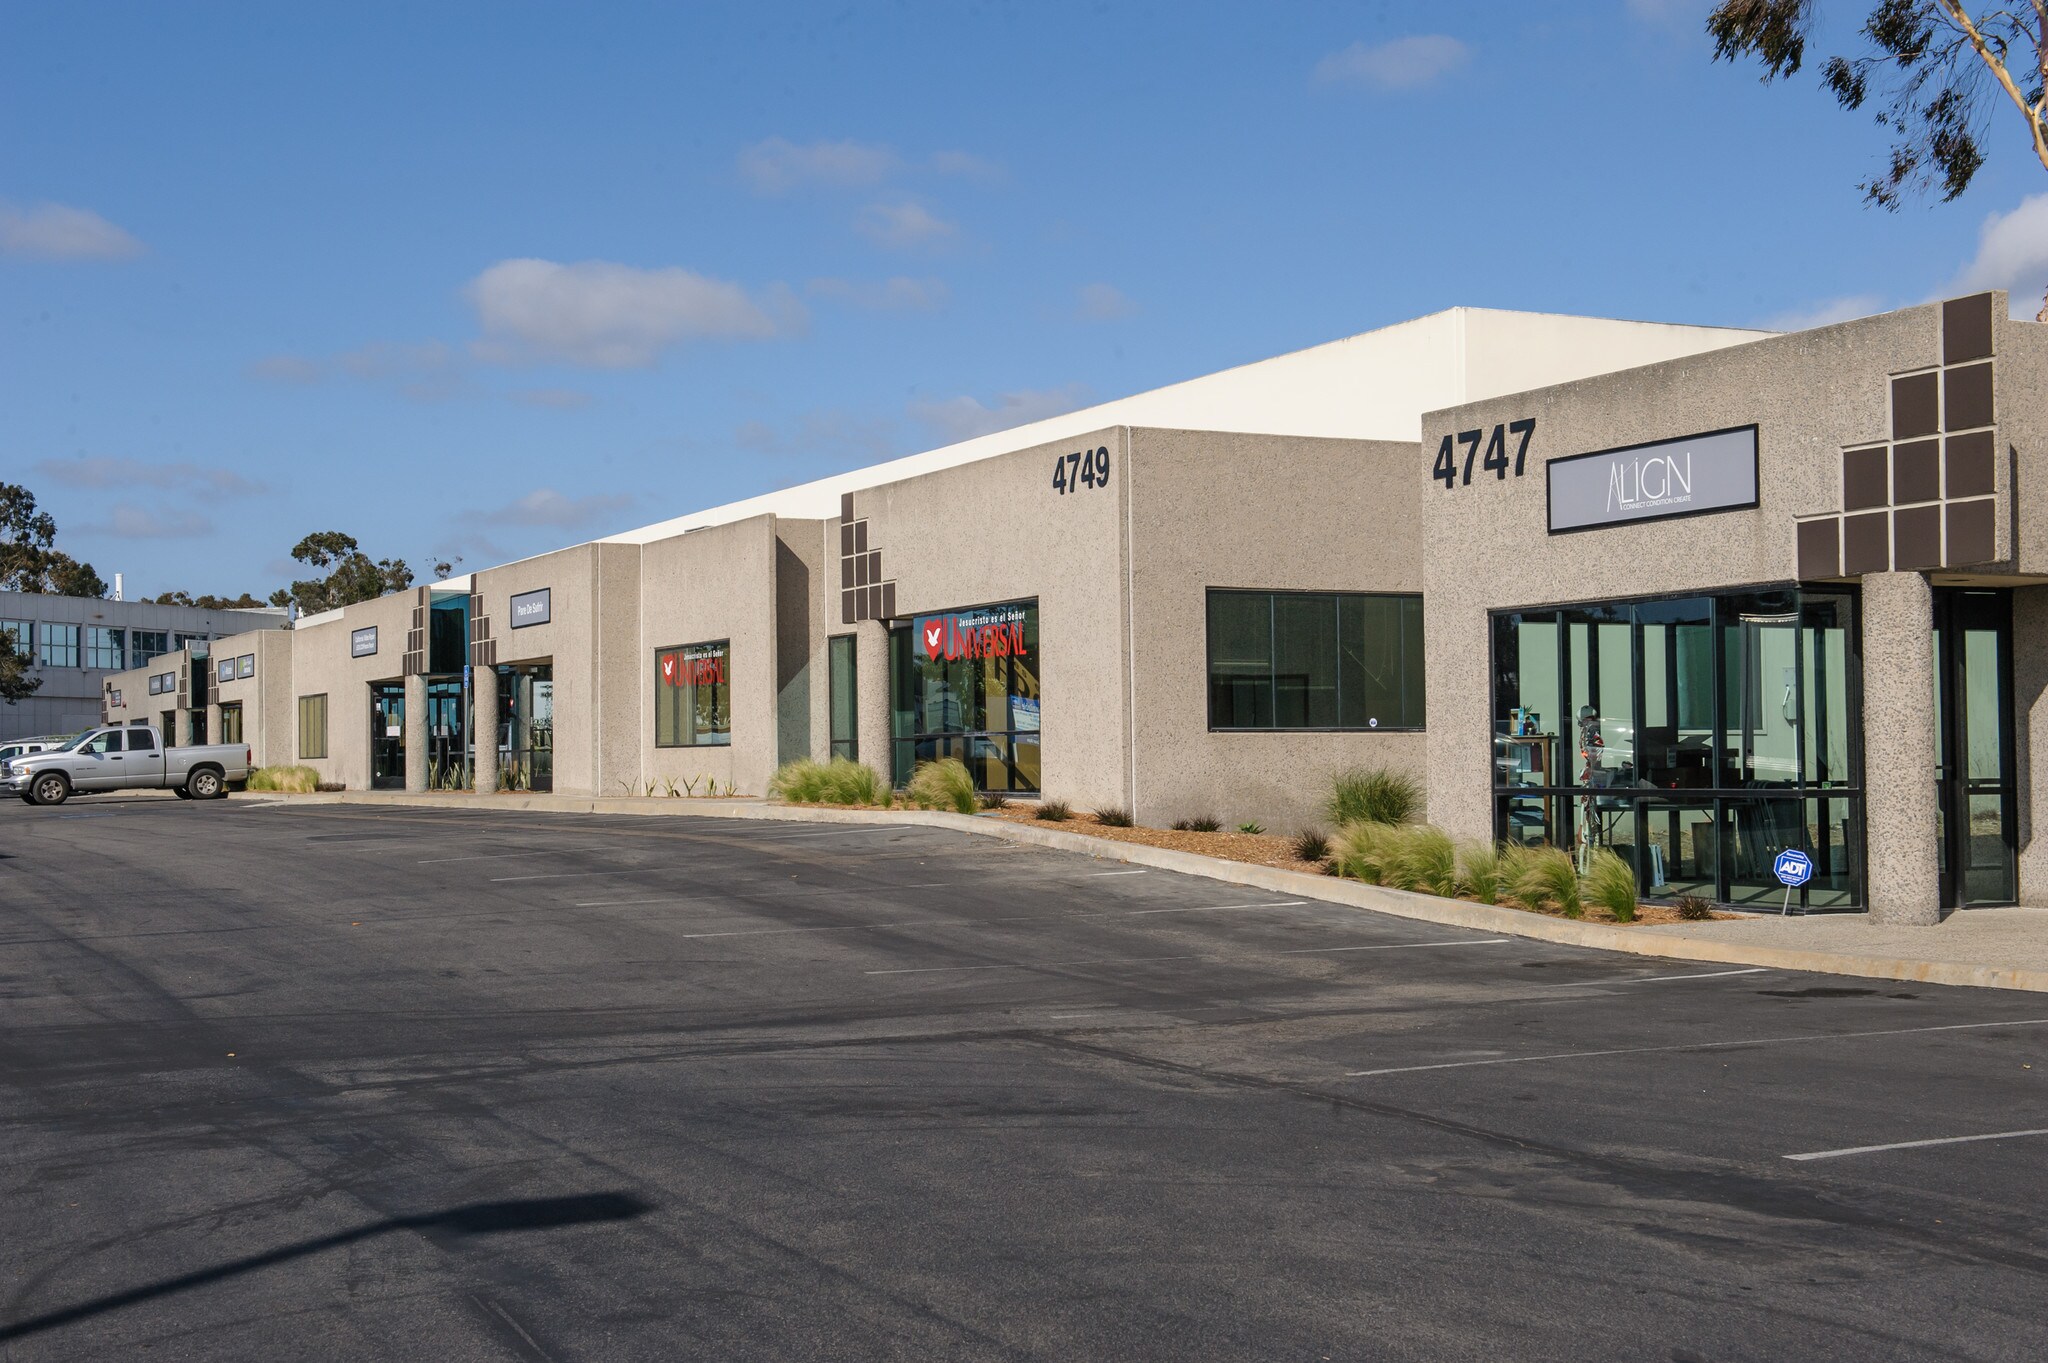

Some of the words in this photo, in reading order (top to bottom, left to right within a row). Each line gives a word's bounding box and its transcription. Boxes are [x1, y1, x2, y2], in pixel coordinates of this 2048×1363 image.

[1433, 418, 1535, 489] 4747
[1053, 446, 1110, 495] 4749
[1623, 501, 1646, 510] CONNECT
[1646, 498, 1673, 507] CONDITION
[1673, 495, 1691, 503] CREATE
[959, 616, 988, 627] Jesucristo
[991, 615, 997, 623] es
[1000, 613, 1006, 622] el
[1008, 610, 1025, 621] Señor
[943, 616, 1026, 661] UNIVERSAL
[1780, 861, 1806, 876] ADT
